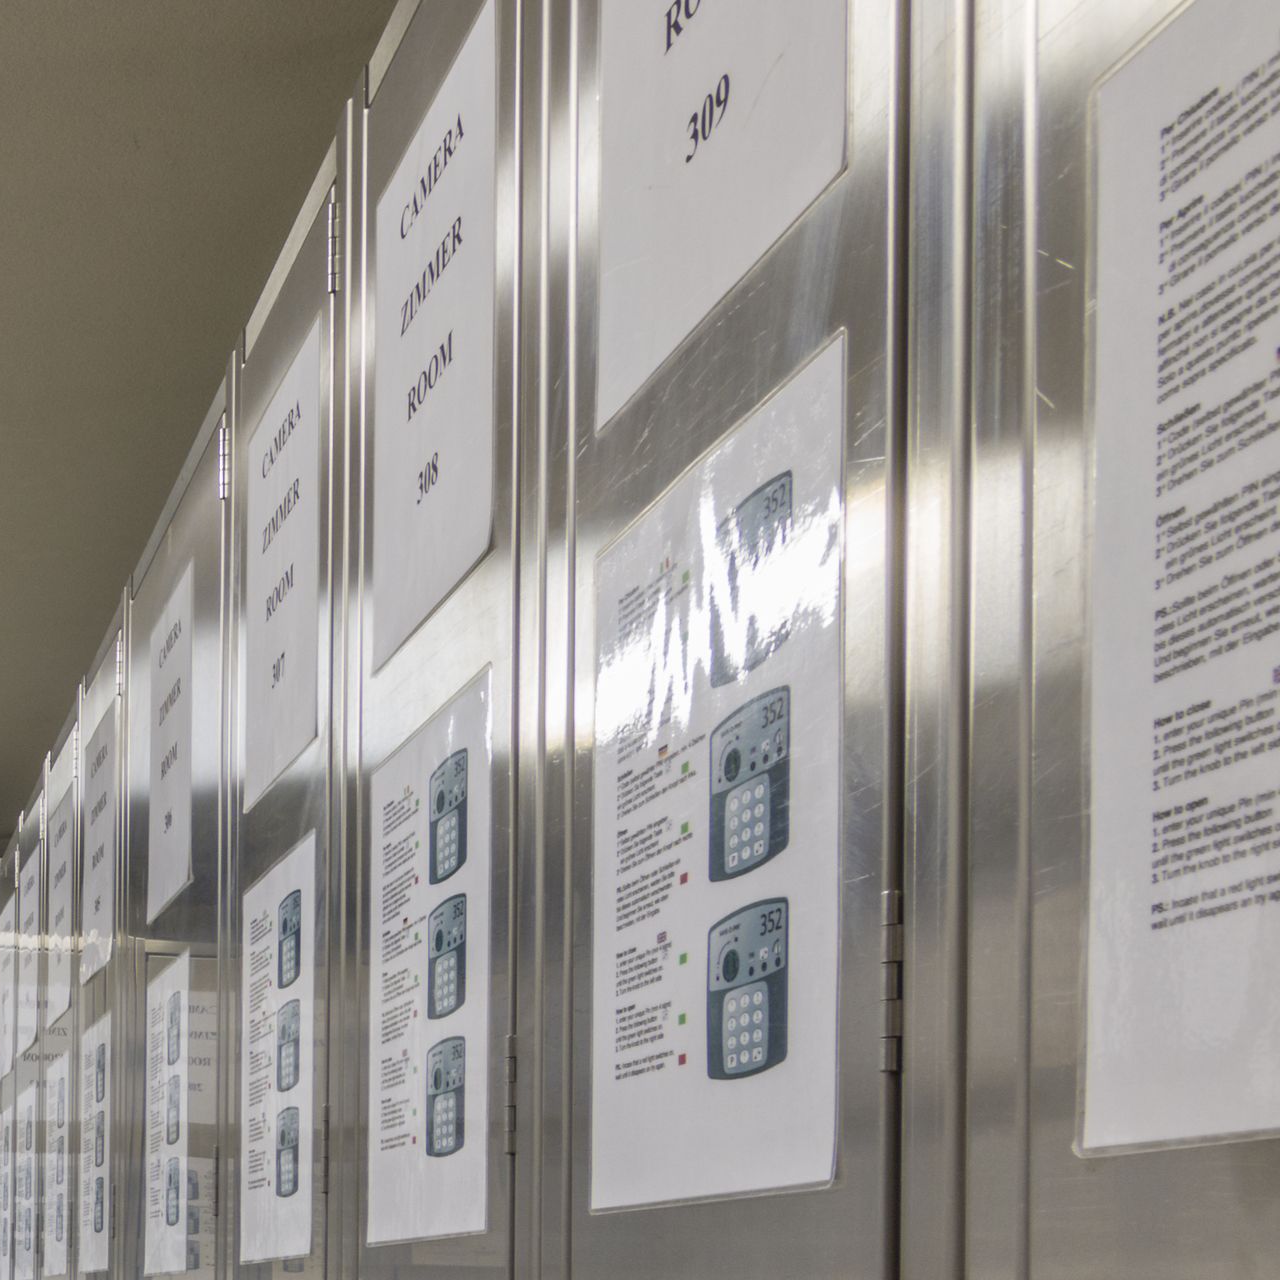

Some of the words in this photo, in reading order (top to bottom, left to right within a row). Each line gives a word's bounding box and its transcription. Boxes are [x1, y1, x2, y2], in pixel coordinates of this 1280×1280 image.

[685, 73, 730, 163] 309
[400, 114, 465, 240] CAMERA
[400, 215, 463, 337] ZIMMER
[407, 330, 453, 422] ROOM
[261, 400, 302, 479] CAMERA
[416, 451, 439, 505] 308
[763, 483, 786, 520] 352
[262, 477, 300, 555] ZIMMER
[265, 562, 294, 622] ROOM
[271, 651, 286, 690] 307
[761, 697, 784, 730] 352
[760, 908, 782, 936] 352
